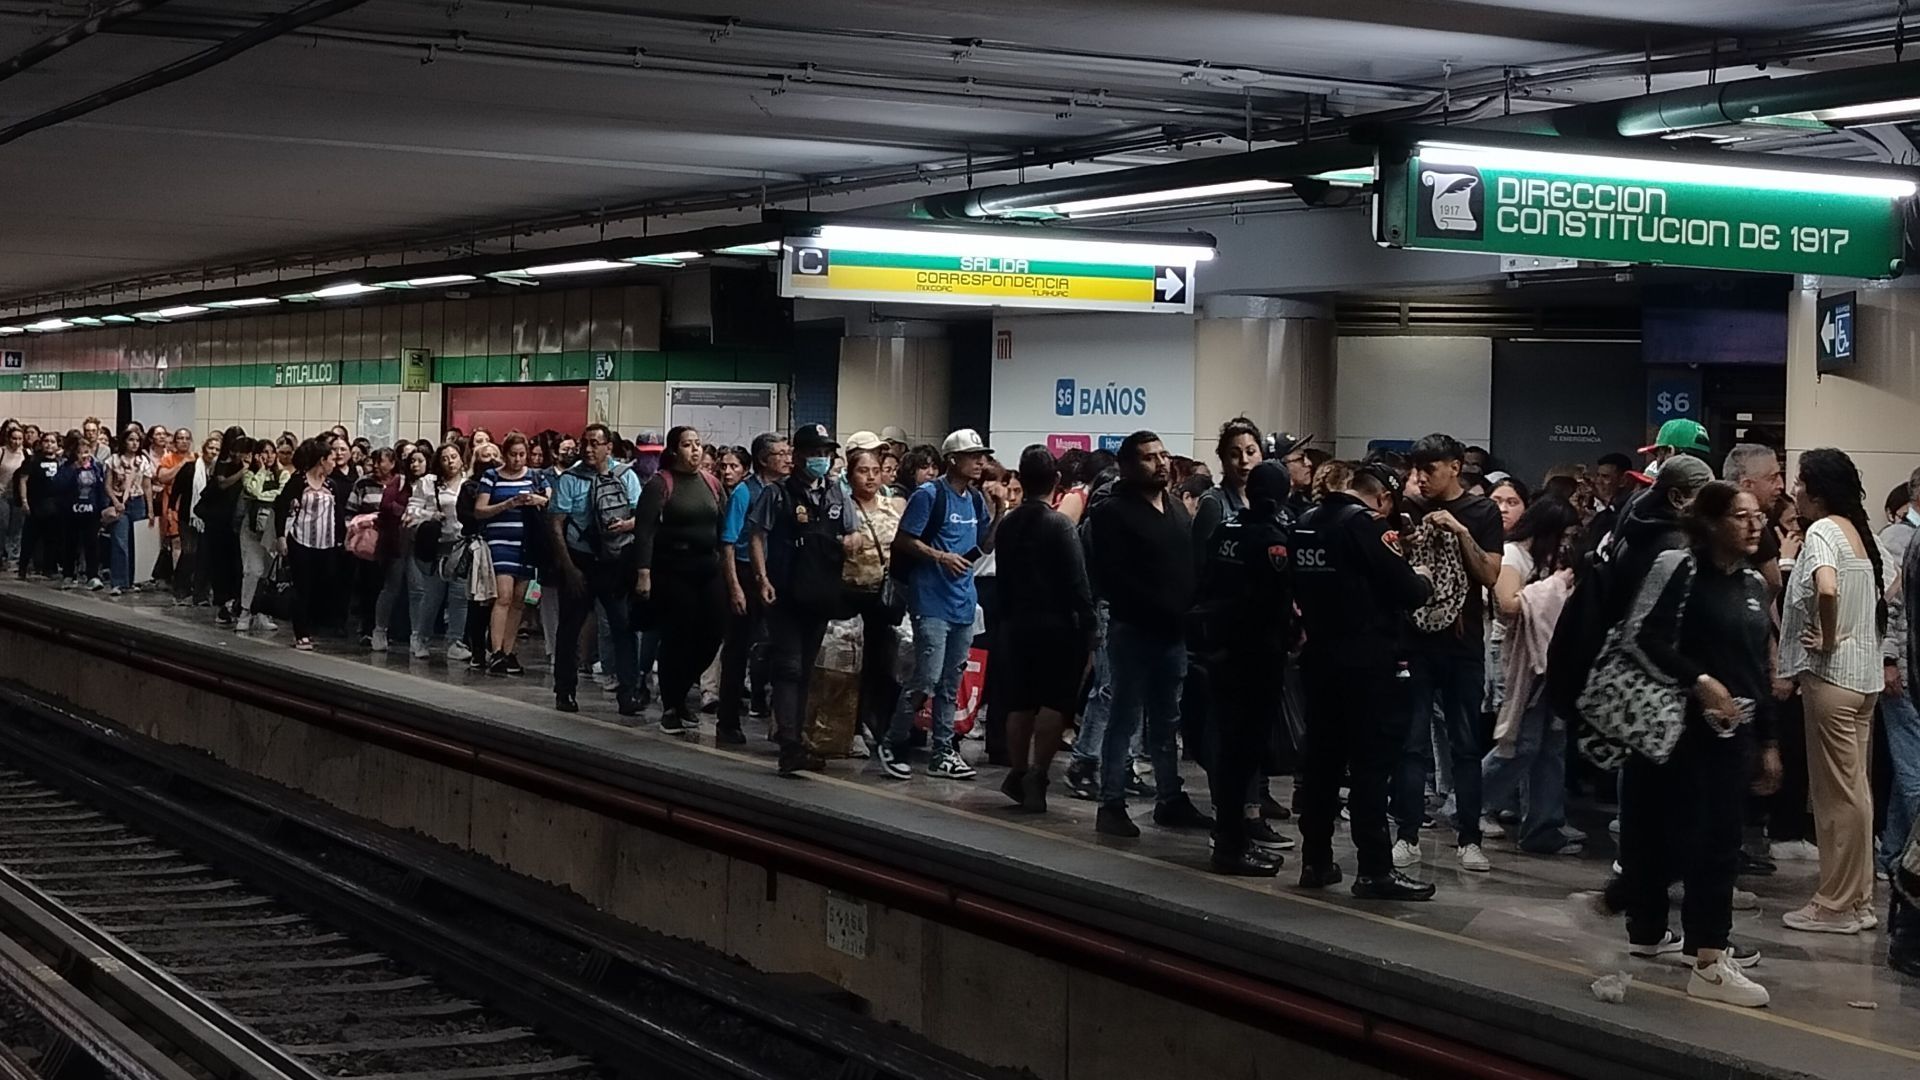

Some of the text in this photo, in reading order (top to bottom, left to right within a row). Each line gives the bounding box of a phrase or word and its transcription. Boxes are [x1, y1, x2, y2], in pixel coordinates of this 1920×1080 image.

[1497, 176, 1667, 215] DIRECCION
[1440, 204, 1460, 216] 1917
[1497, 206, 1850, 255] CONSTITUCION DE 1917
[798, 247, 823, 274] C
[960, 256, 1029, 274] SALIDA
[916, 271, 1069, 289] CORRESPONDENCIA
[916, 284, 953, 292] MIXCOAC
[1032, 289, 1069, 297] TLAHUAC
[285, 363, 333, 385] ATLALILCO
[1057, 381, 1147, 416] $6 BAÑOS
[1656, 391, 1691, 415] $6
[1553, 424, 1598, 436] SALIDA
[1296, 547, 1327, 566] SSC
